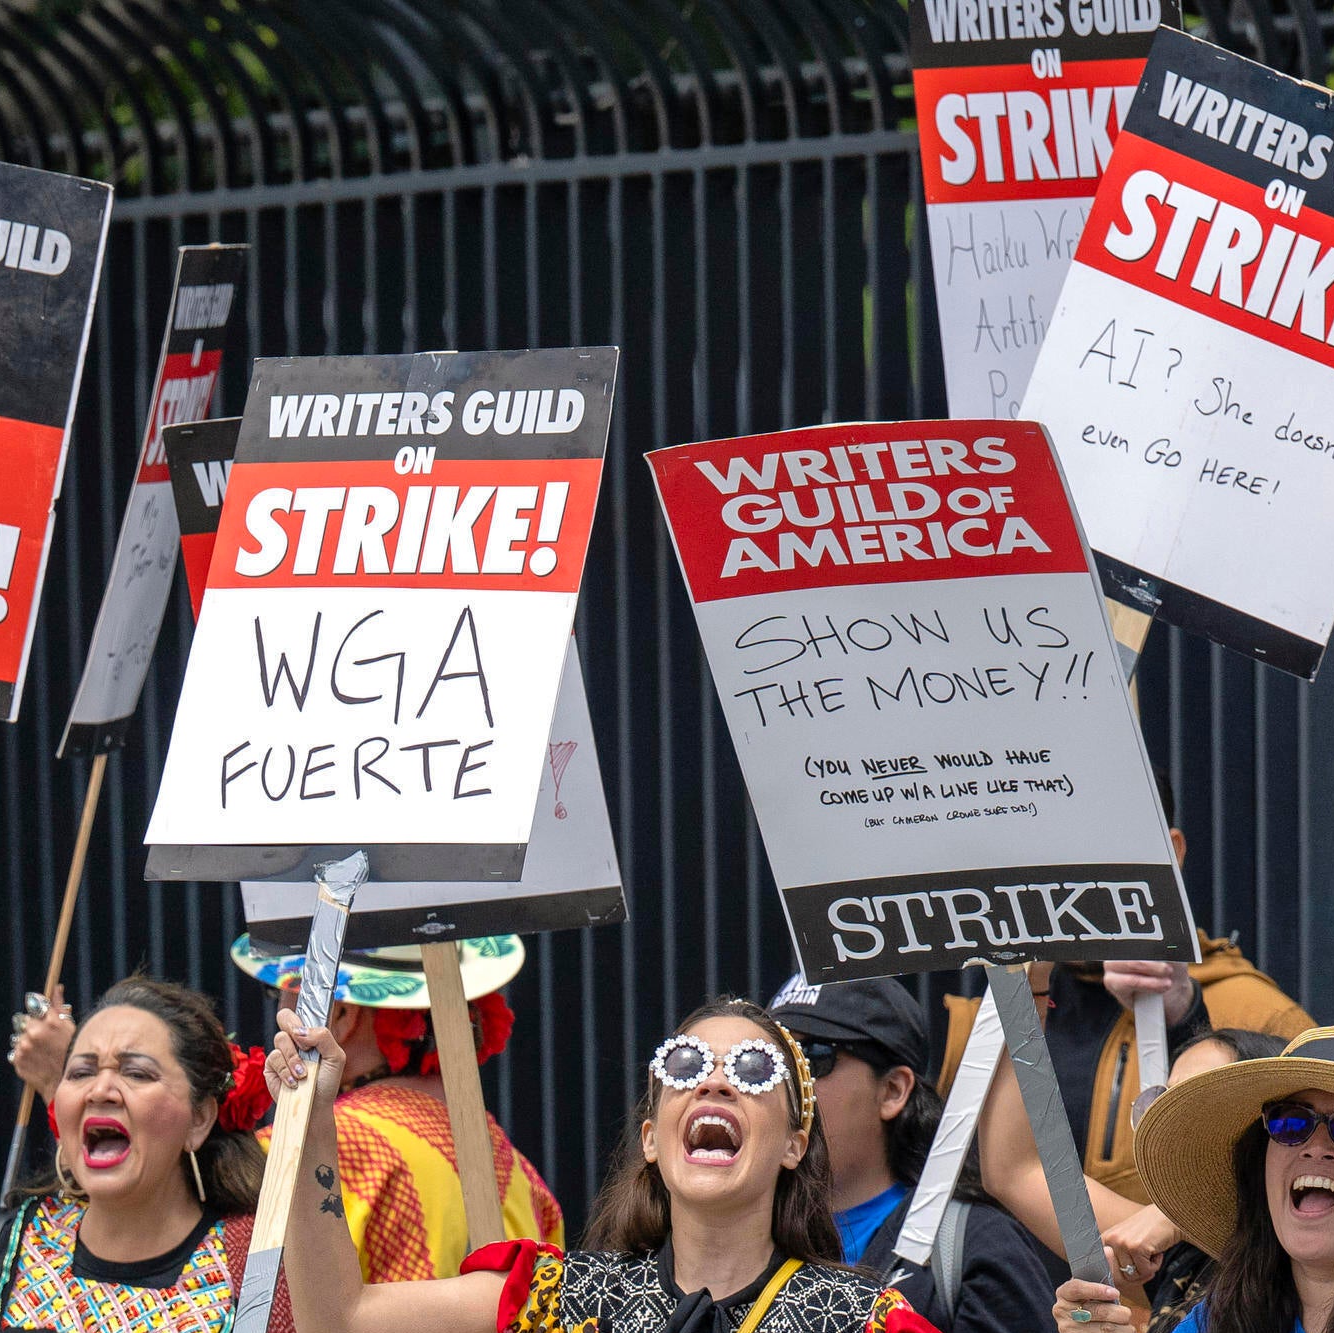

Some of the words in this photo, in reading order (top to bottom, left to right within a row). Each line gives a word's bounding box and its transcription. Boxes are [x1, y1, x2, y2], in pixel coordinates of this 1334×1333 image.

[924, 0, 1065, 43] WRITERS
[1068, 0, 1162, 37] GUILD
[1031, 48, 1063, 80] ON
[935, 85, 1138, 185] STRIK
[1157, 71, 1333, 181] WRITERS
[1264, 178, 1307, 219] ON
[946, 209, 1030, 286] Haiku
[268, 391, 454, 439] WRITERS
[463, 388, 585, 435] GUILD
[1194, 377, 1254, 425] She
[394, 446, 435, 476] ON
[693, 437, 1016, 495] WRITERS
[1081, 424, 1129, 453] even
[1199, 458, 1280, 505] HERE!
[235, 481, 569, 577] STRIKE!
[720, 483, 940, 533] GUILD
[947, 486, 1014, 517] OF
[720, 517, 1051, 579] AMERICA
[254, 605, 495, 729] WGA
[735, 609, 949, 674] SHOW
[983, 607, 1069, 648] US
[734, 678, 845, 727] THE
[866, 651, 1094, 710] MONEY!!
[221, 737, 495, 810] FUERTE
[804, 756, 851, 778] (YOU
[862, 756, 927, 780] NEVER
[934, 751, 993, 770] WOULD
[1005, 749, 1051, 765] HAVE
[819, 789, 869, 805] COME
[875, 787, 895, 803] UP
[940, 781, 978, 798] LINE
[987, 779, 1018, 794] LIKE
[892, 813, 939, 825] CAMERON
[827, 881, 1165, 963] STRIKE
